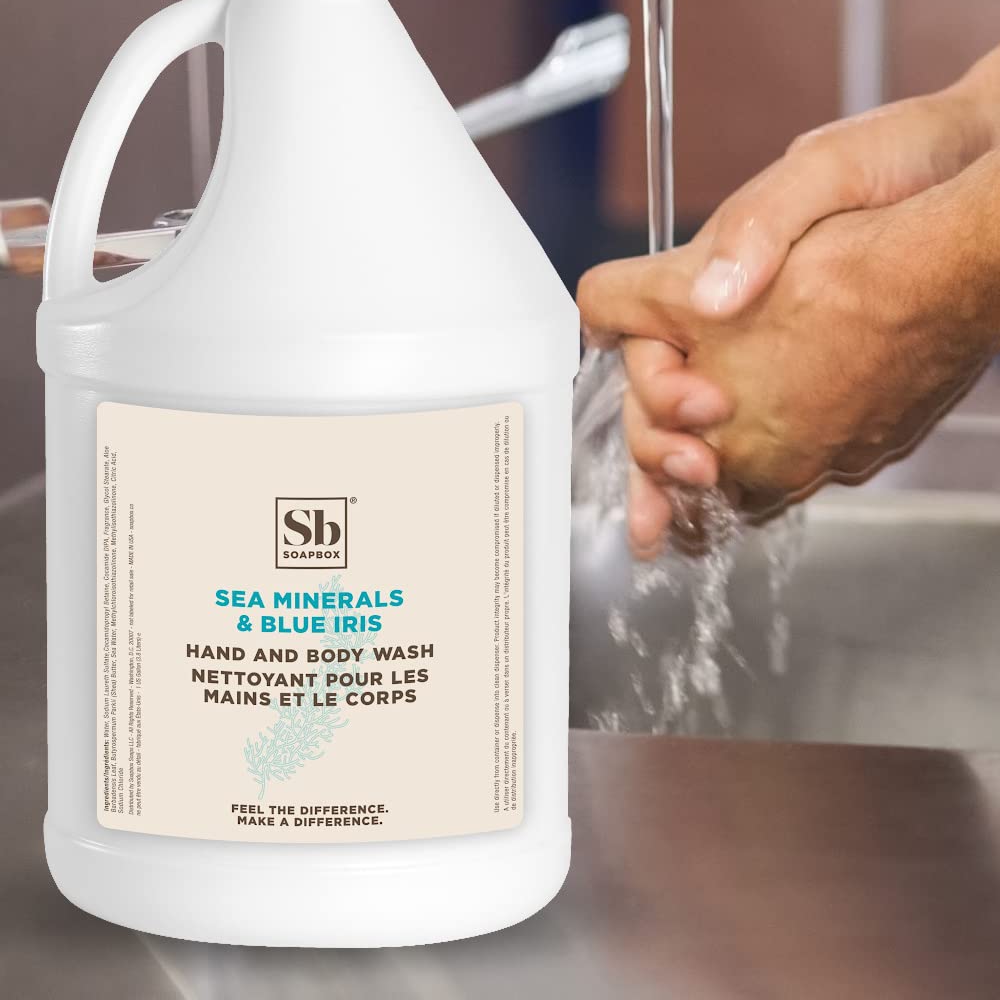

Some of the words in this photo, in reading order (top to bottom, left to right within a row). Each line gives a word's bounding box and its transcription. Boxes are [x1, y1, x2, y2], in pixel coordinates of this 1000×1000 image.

[284, 510, 341, 546] Sb
[283, 551, 340, 559] SOAPBOX
[216, 590, 264, 608] SEA
[274, 590, 403, 609] MINERALS
[237, 615, 252, 632] &
[262, 616, 325, 633] BLUE
[334, 615, 382, 632] IRIS
[187, 644, 245, 660] HAND
[253, 649, 298, 662] AND
[307, 649, 363, 663] BODY
[373, 644, 433, 661] WASH
[192, 669, 317, 687] NETTOYANT
[327, 672, 382, 687] POUR
[392, 669, 428, 684] LES
[205, 689, 270, 705] MAINS
[280, 693, 305, 706] ET
[314, 693, 336, 706] LE
[346, 689, 416, 706] CORPS
[232, 804, 264, 814] FEEL
[270, 806, 294, 814] THE
[301, 805, 388, 815] DIFFERENCE.
[238, 816, 274, 826] MAKE
[280, 818, 289, 826] A
[295, 816, 382, 826] DIFFERENCE.
